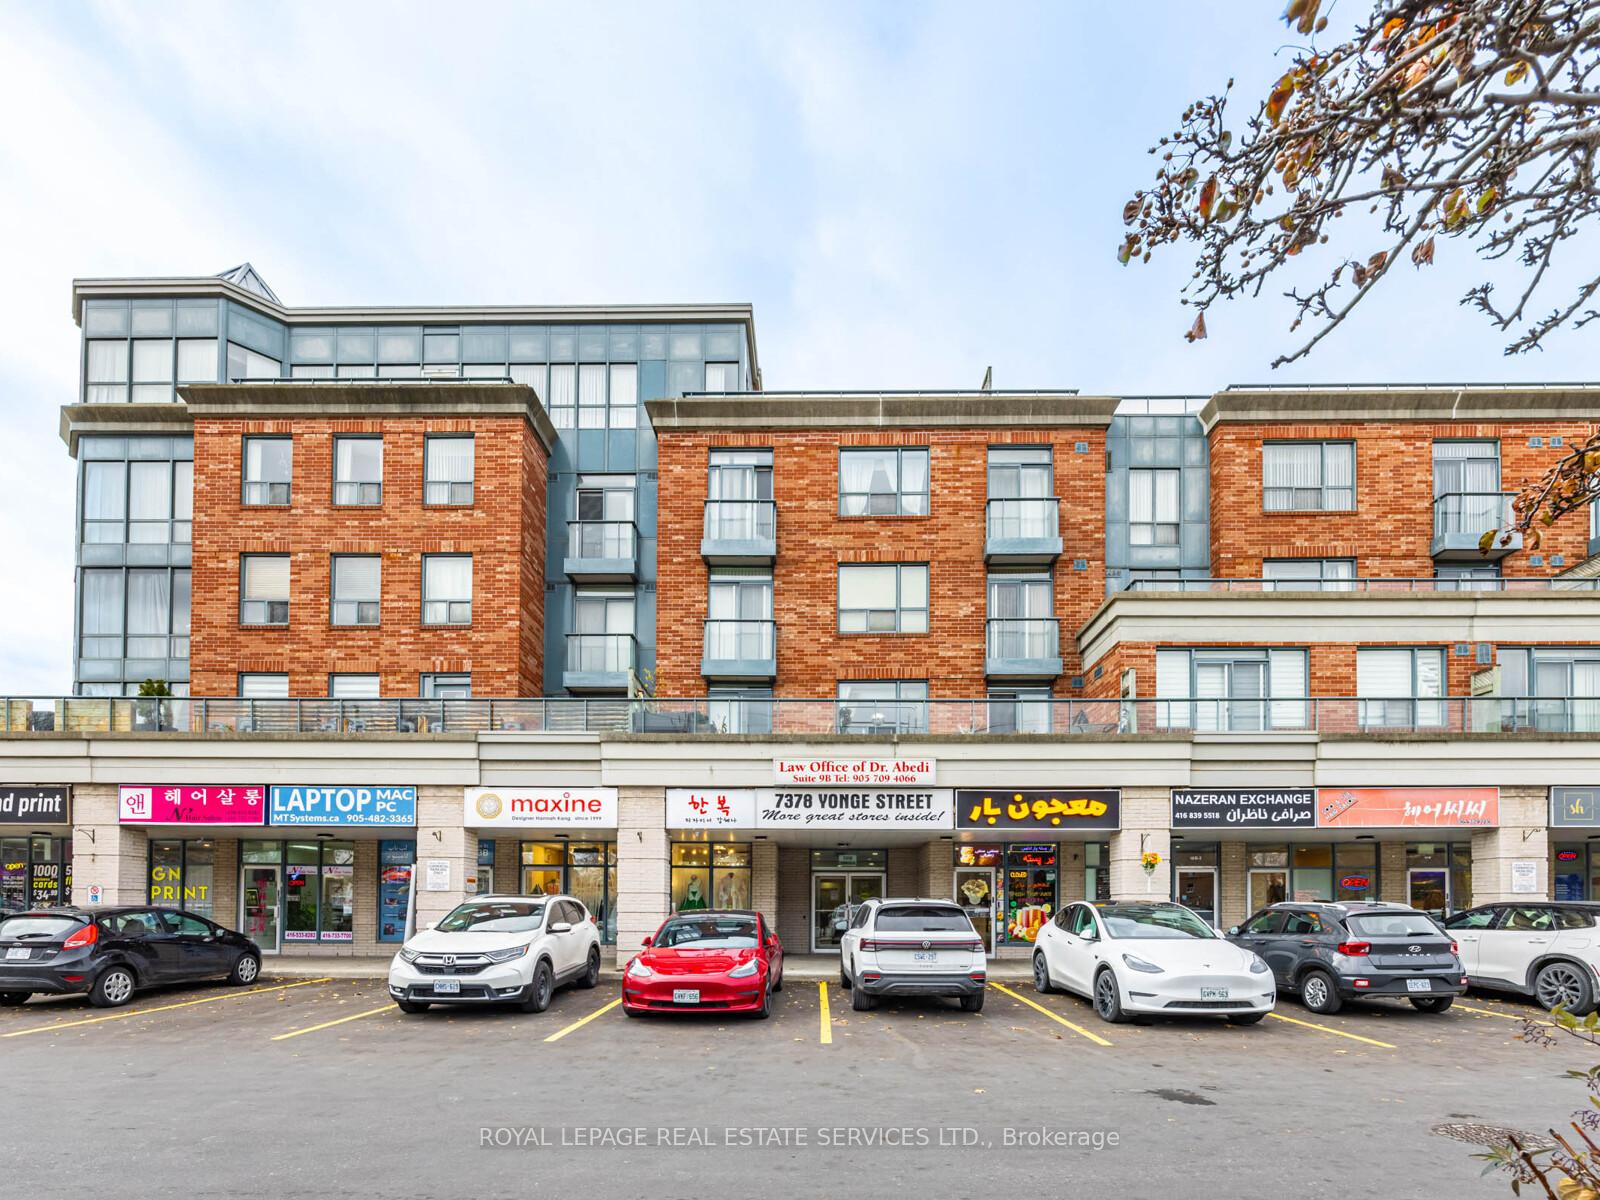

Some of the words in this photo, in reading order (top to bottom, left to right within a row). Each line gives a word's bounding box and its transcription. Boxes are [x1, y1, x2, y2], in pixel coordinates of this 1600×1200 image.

[780, 761, 806, 772] Law
[810, 760, 848, 772] Office
[852, 760, 866, 772] of
[869, 761, 888, 772] Dr.
[893, 761, 929, 772] Abedi
[793, 774, 816, 782] Suite
[819, 774, 831, 782] 9B
[835, 774, 850, 782] Tel:
[853, 774, 869, 782] 905
[874, 774, 890, 782] 709
[893, 774, 916, 782] 4066
[274, 788, 371, 812] LAPTOP
[376, 789, 412, 800] MAC
[775, 794, 812, 809] 7378
[818, 794, 872, 809] YONGE
[876, 794, 933, 809] STREET
[1175, 794, 1236, 805] NAZERAN
[1240, 794, 1311, 804] EXCHANGE
[0, 793, 14, 812] d
[18, 792, 62, 817] print
[126, 793, 145, 814] 앤
[376, 801, 397, 812] PC
[511, 792, 602, 812] maxine
[1008, 793, 1107, 825] معجون
[762, 810, 800, 821] More
[806, 812, 845, 824] great
[849, 812, 889, 821] stores
[895, 811, 945, 821] inside!
[969, 797, 1001, 825] بار
[346, 814, 413, 823] 905-482-3365
[33, 865, 58, 876] 1000
[152, 866, 180, 881] GN
[33, 880, 58, 888] cards
[1343, 878, 1369, 887] OPEN
[151, 885, 208, 900] PRINT
